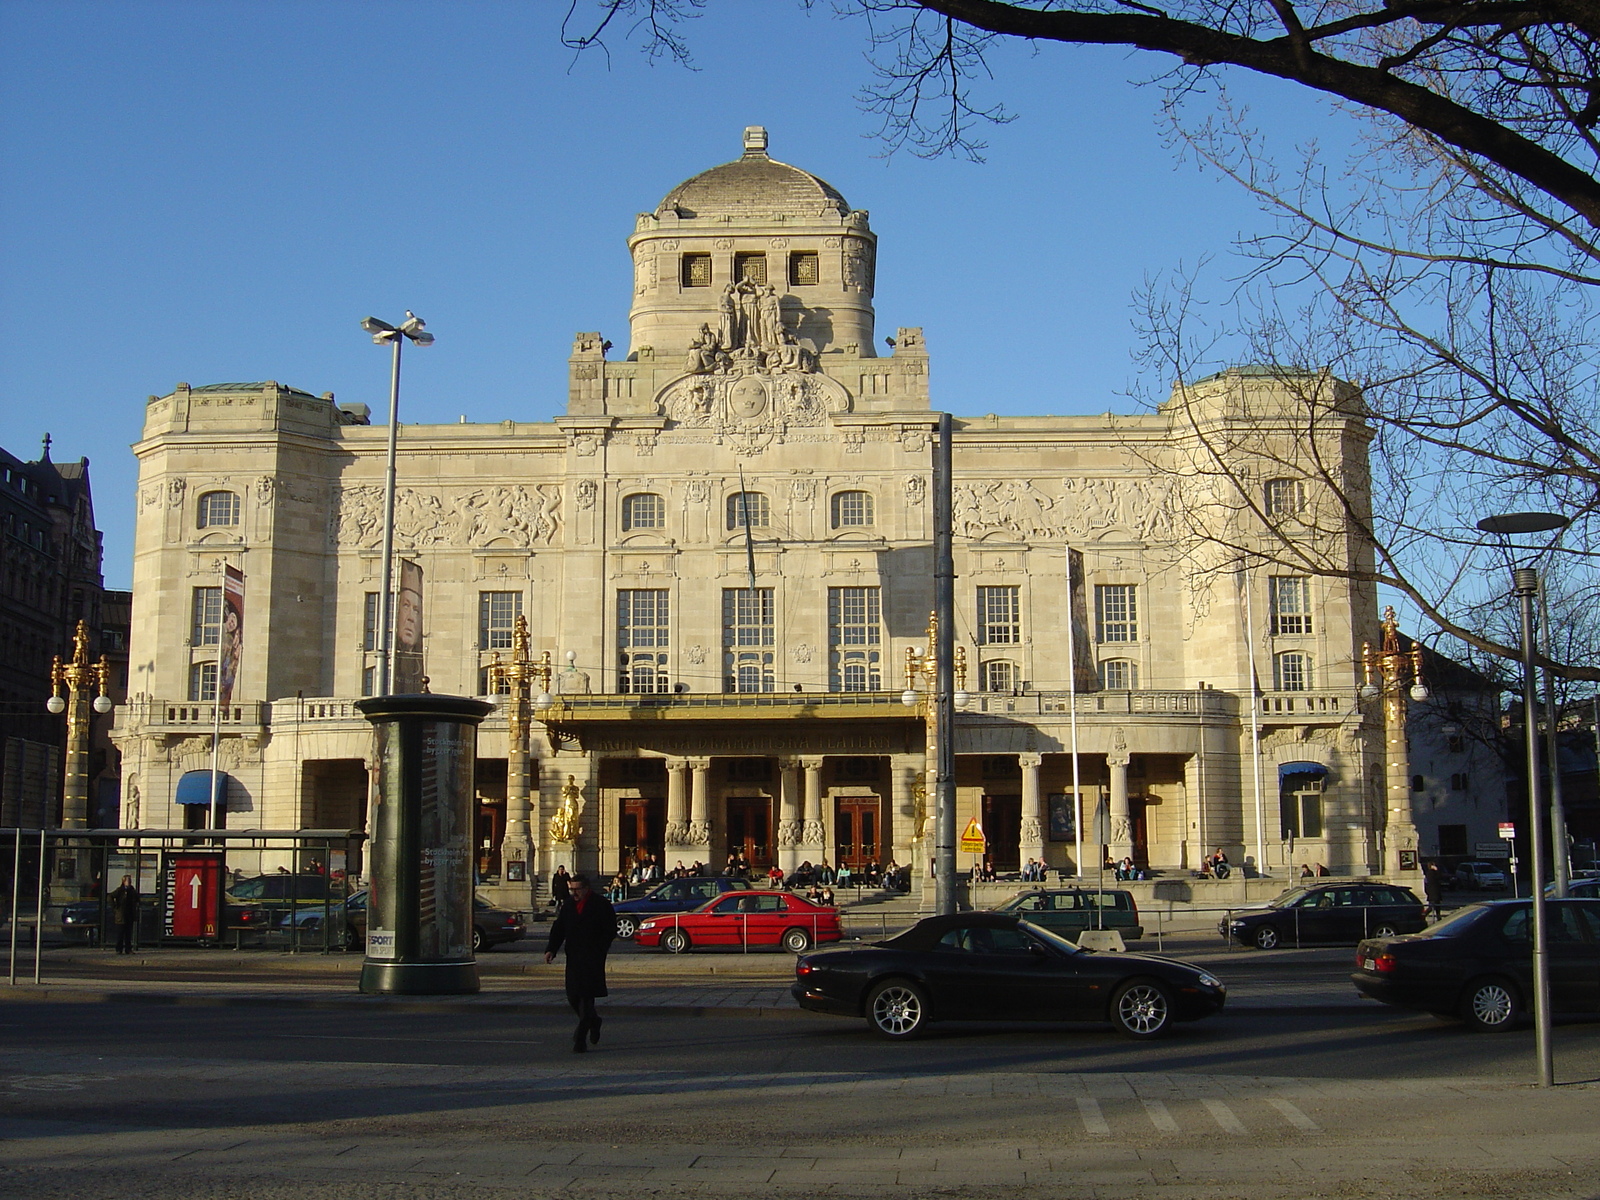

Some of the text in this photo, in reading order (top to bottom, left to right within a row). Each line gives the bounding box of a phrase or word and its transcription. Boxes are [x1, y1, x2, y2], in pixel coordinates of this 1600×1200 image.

[427, 737, 462, 747] Stockholm
[698, 736, 809, 749] DRAMATISKA
[818, 735, 891, 749] TEATERN
[425, 847, 461, 857] Stockholm
